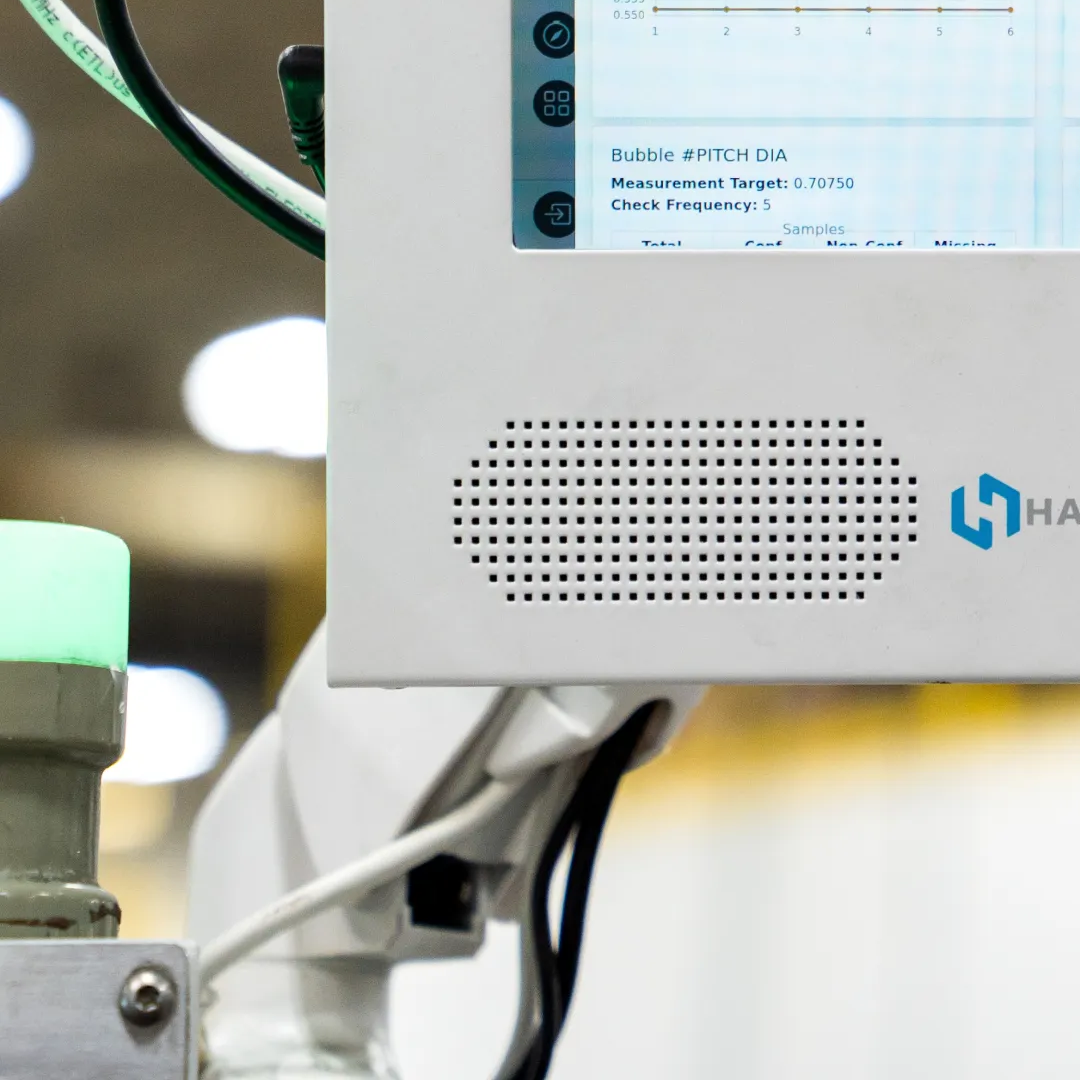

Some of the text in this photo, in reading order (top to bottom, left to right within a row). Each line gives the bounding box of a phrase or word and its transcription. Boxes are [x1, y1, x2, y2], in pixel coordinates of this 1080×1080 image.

[613, 9, 645, 20] 0.550
[652, 26, 1014, 37] 1 2 3 4 5 6
[611, 147, 788, 163] Bubble #PITCH DIA
[611, 177, 854, 192] Measurement Target: 0.70750
[610, 198, 771, 214] Check Frequency: 5
[782, 223, 845, 237] Samples
